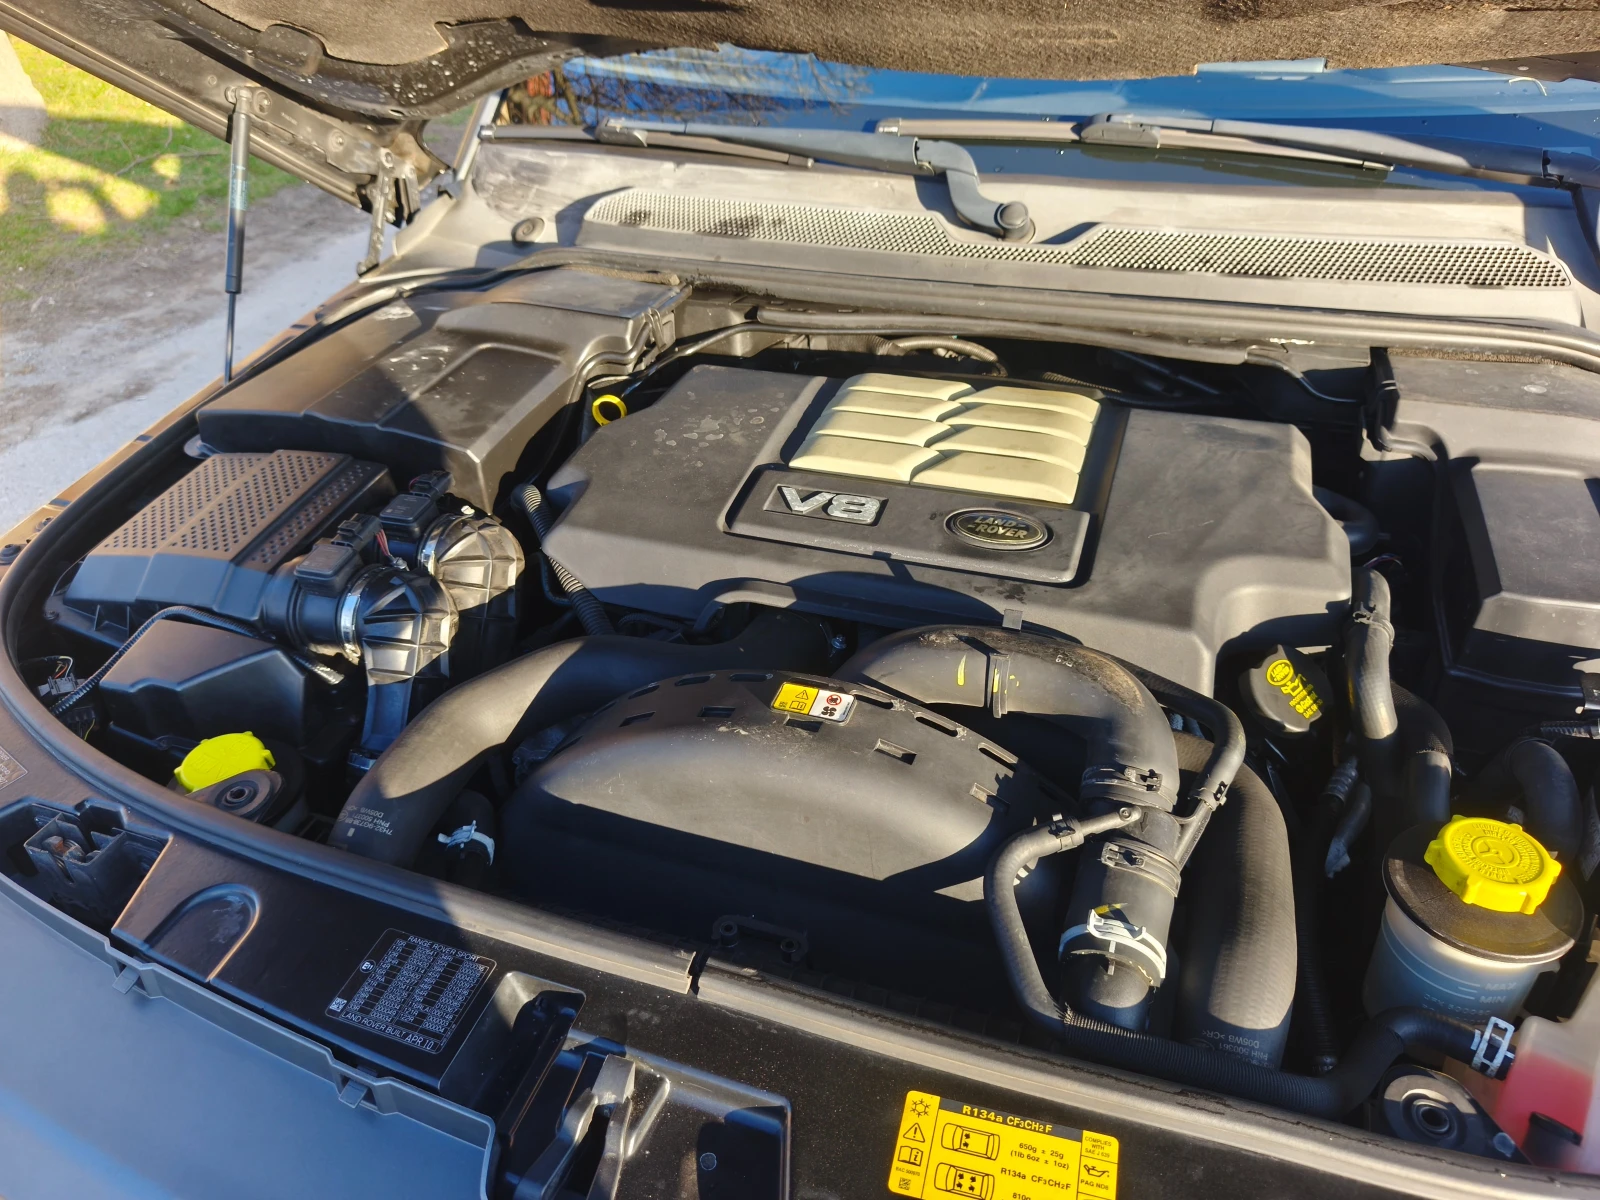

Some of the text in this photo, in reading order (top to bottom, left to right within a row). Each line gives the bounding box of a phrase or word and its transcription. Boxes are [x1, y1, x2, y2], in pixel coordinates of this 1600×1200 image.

[781, 486, 881, 523] V8
[974, 516, 1018, 528] LAND
[979, 524, 1028, 539] ROVER
[407, 935, 479, 963] RANGE ROVER SPORT
[1485, 982, 1517, 991] MAX
[1479, 996, 1506, 1004] MIN
[340, 1010, 434, 1049] LAND ROVER BUILT APR 10
[1251, 1049, 1269, 1061] PNH
[962, 1104, 1003, 1123] R134a
[1085, 1136, 1112, 1146] COMPLIES
[1019, 1142, 1037, 1154] 650g
[1050, 1149, 1064, 1160] 25g
[1026, 1154, 1040, 1162] 6oz
[1054, 1160, 1070, 1170] 1oz)
[1000, 1167, 1026, 1180] R134a
[1080, 1179, 1094, 1187] PAG
